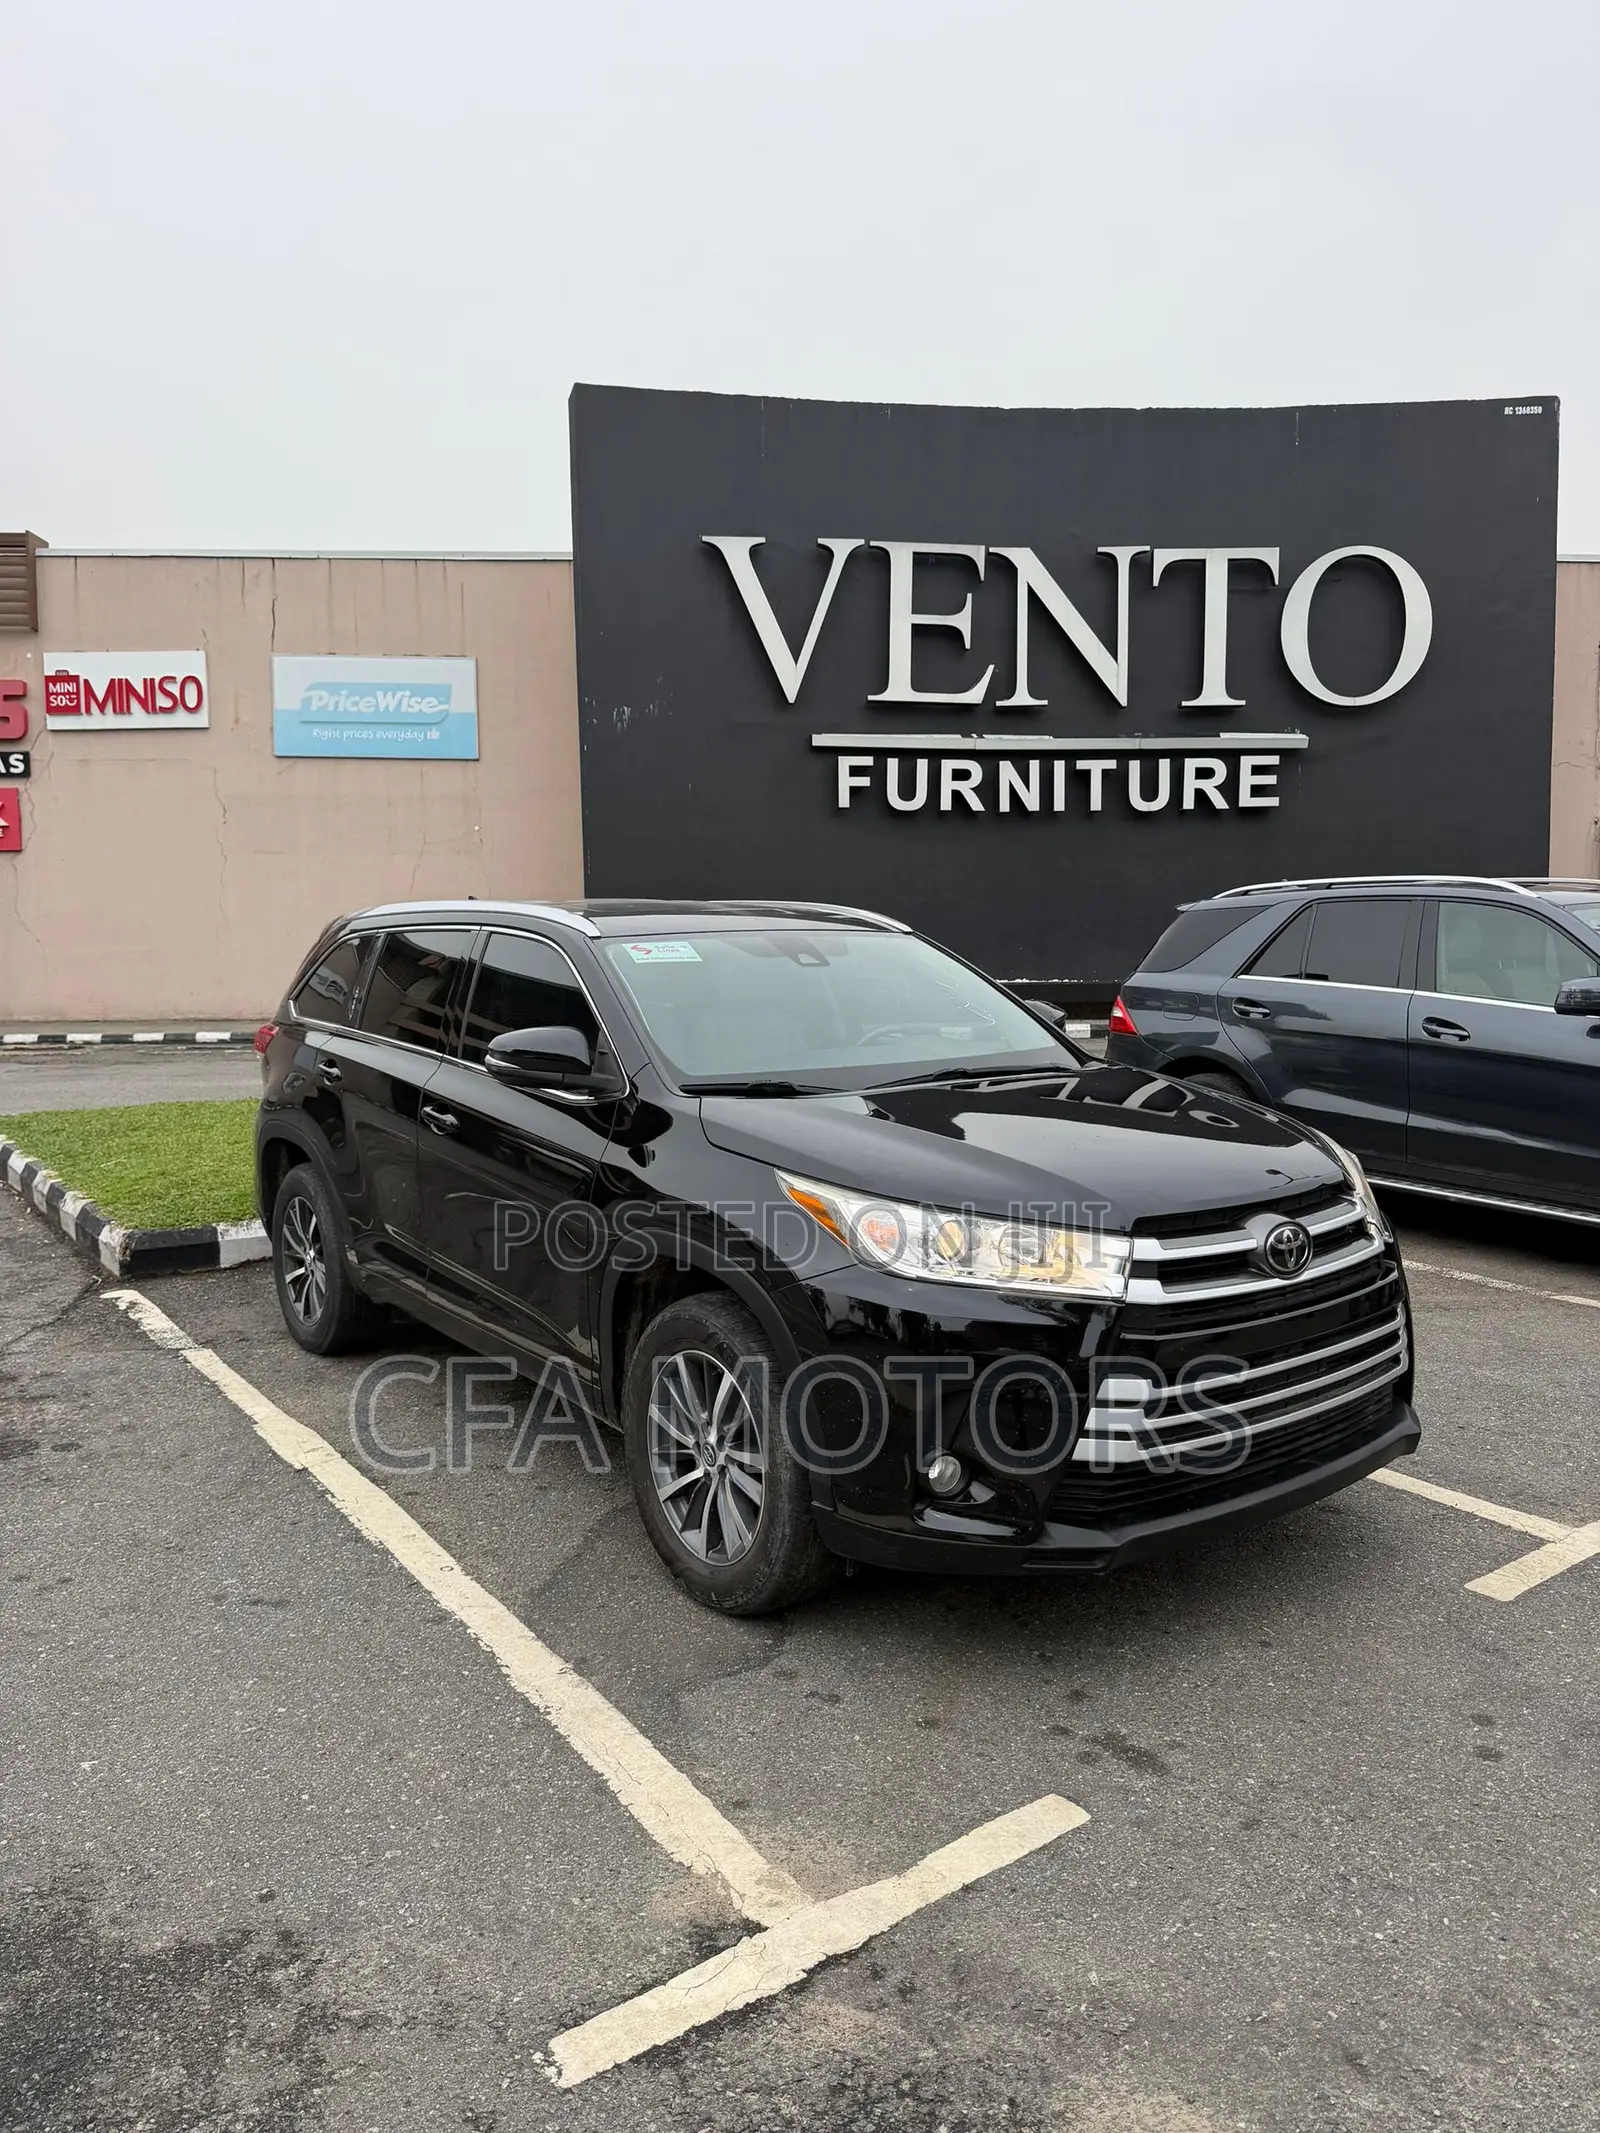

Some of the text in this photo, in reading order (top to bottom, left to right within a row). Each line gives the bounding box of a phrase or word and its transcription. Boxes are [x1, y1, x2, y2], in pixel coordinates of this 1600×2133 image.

[702, 535, 1433, 708] VENTO
[49, 682, 76, 694] MINI
[83, 675, 203, 715] MINISO
[303, 689, 449, 714] PriceWise
[312, 728, 425, 742] Right prices everyday
[837, 755, 1281, 813] FURNITURE
